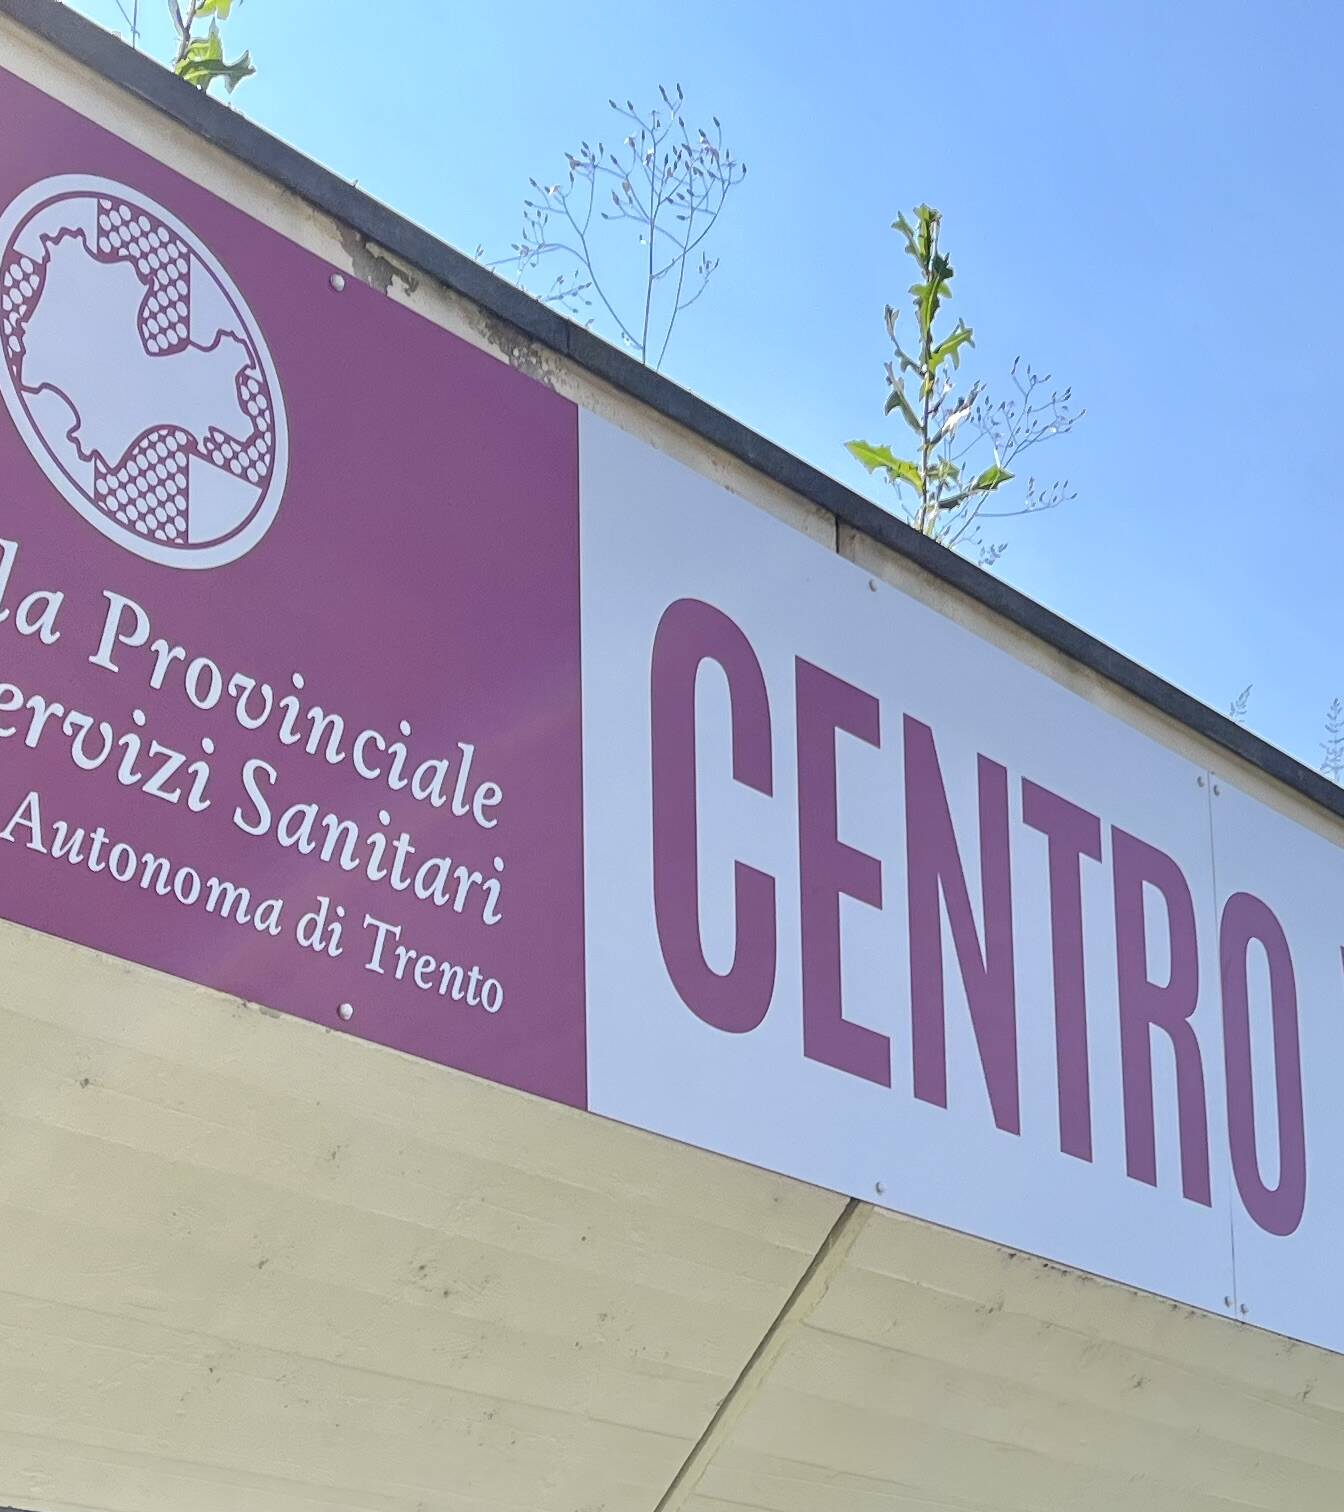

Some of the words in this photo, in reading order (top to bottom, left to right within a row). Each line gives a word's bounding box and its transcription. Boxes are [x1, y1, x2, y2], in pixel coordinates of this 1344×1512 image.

[88, 589, 503, 829] Provinciale
[233, 758, 505, 925] Sanitari
[650, 597, 1307, 1237] CENTRO
[296, 895, 345, 957] di
[363, 913, 504, 1013] Trento
